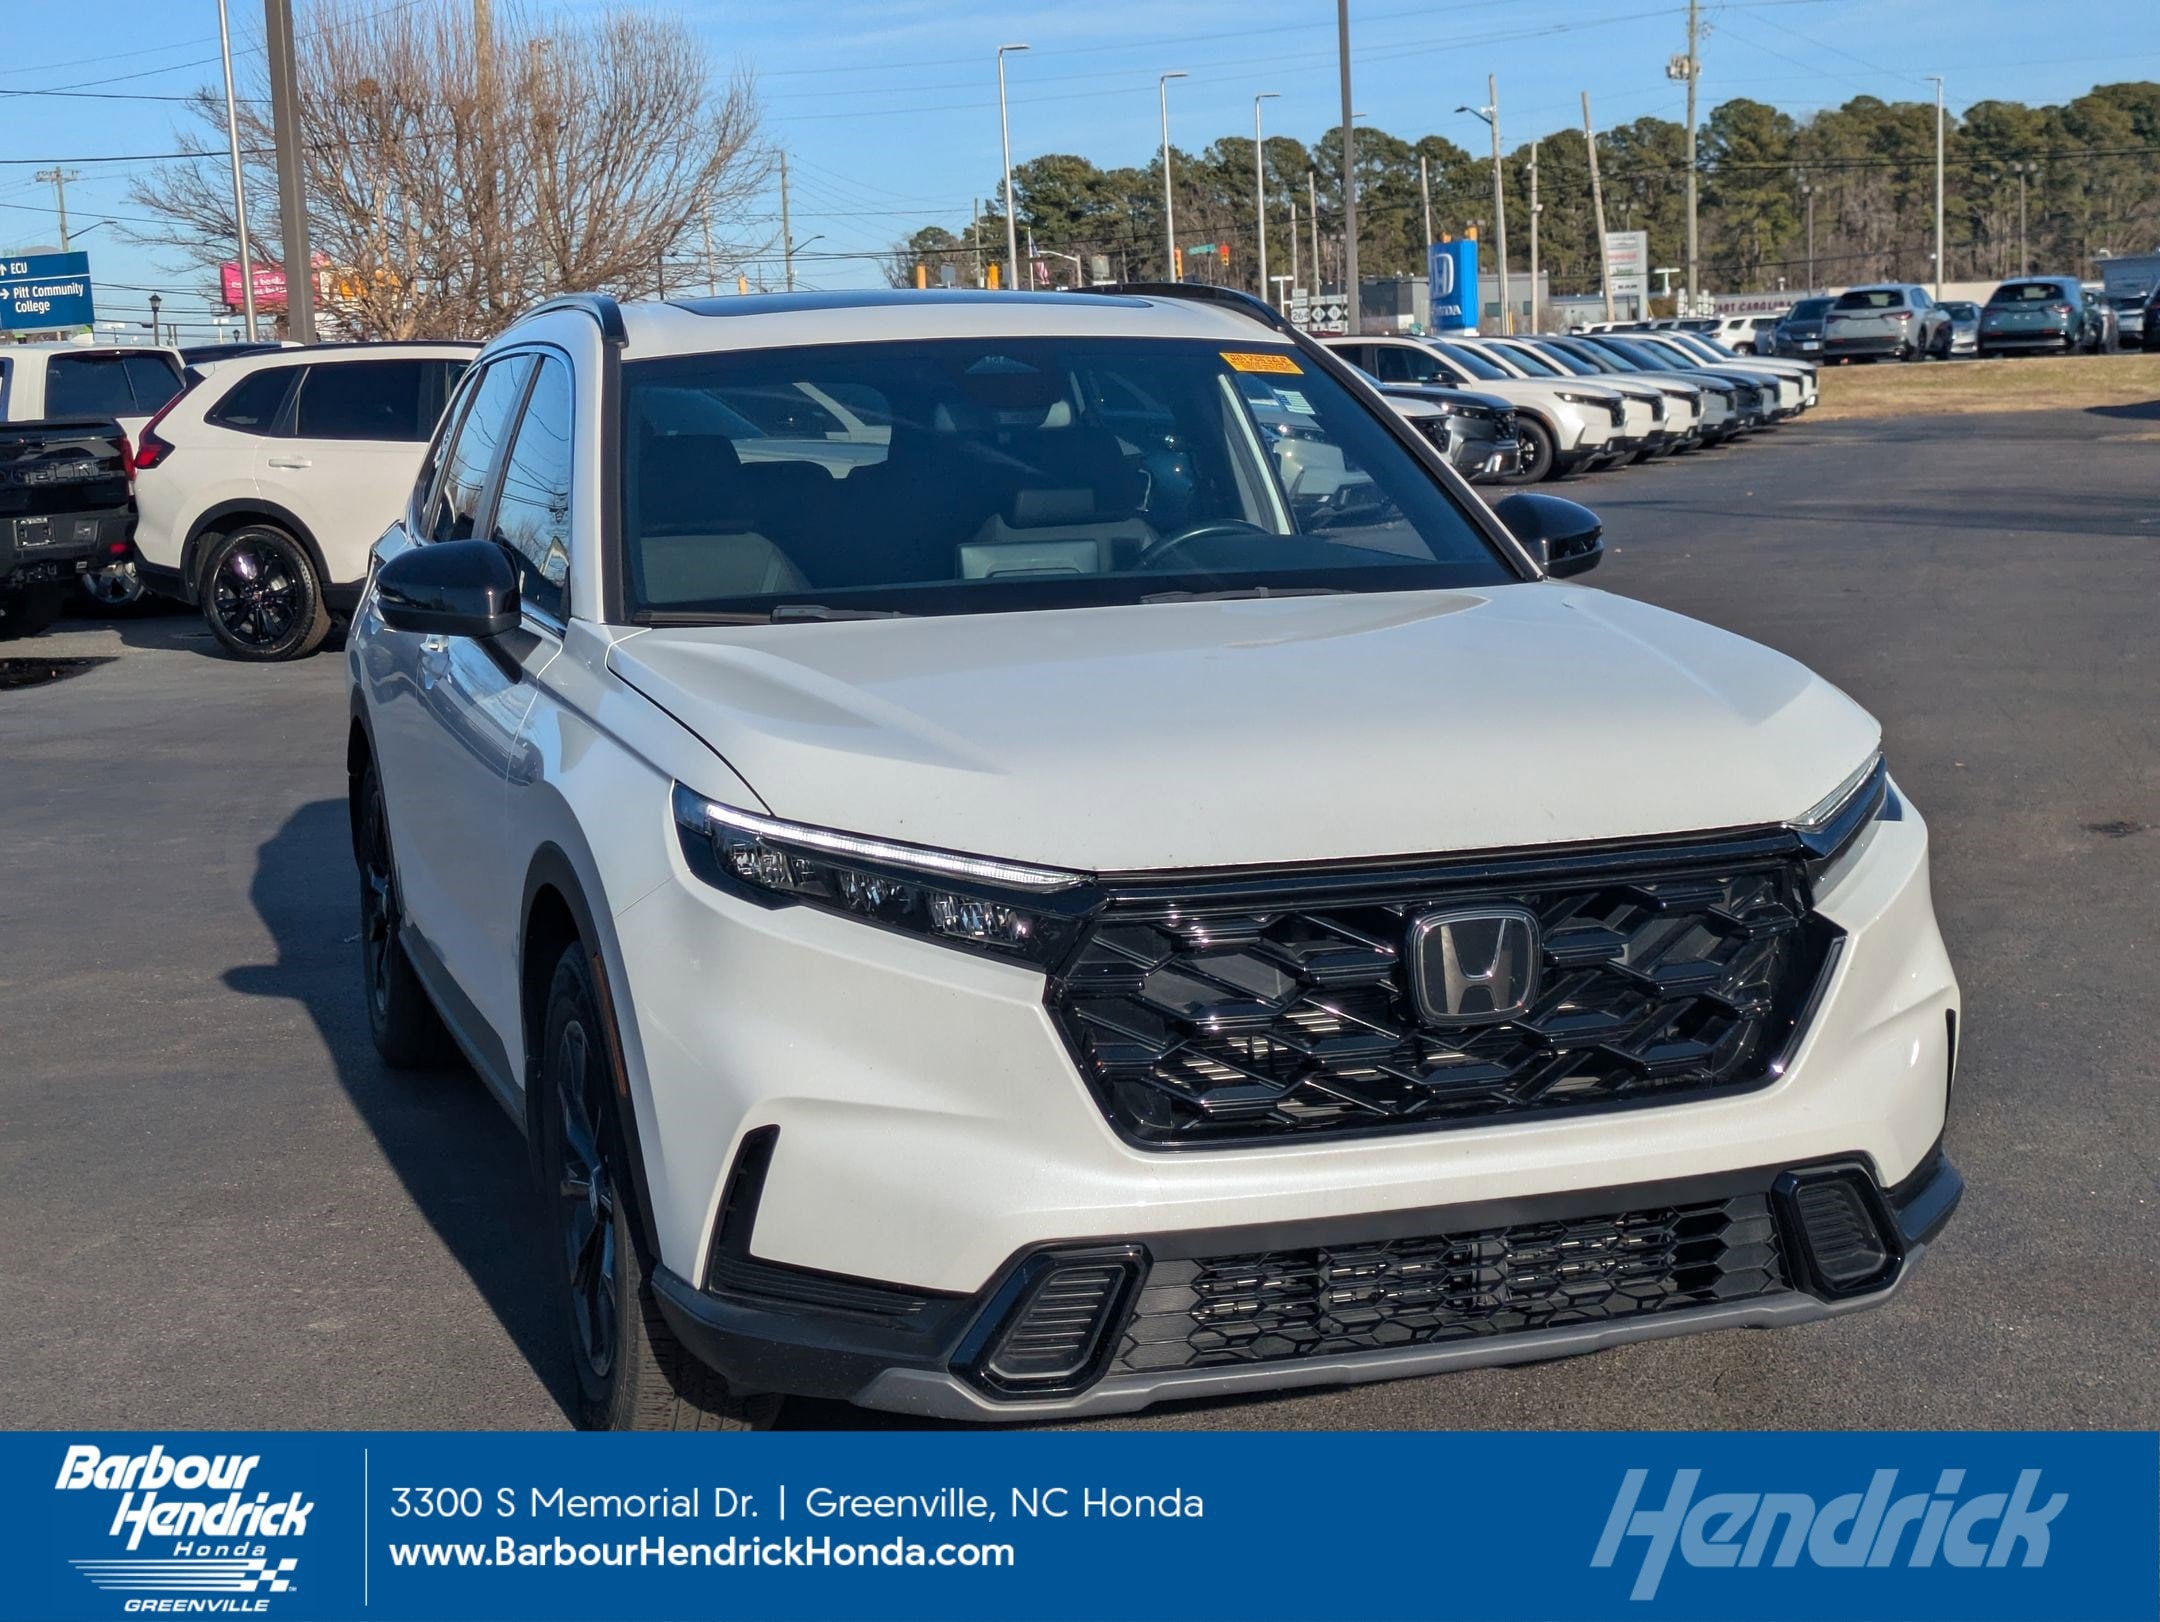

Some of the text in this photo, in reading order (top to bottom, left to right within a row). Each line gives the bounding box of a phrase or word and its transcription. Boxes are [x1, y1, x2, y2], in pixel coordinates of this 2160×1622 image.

[10, 262, 28, 275] ECU
[13, 282, 84, 299] Pitt Community
[15, 300, 51, 314] College
